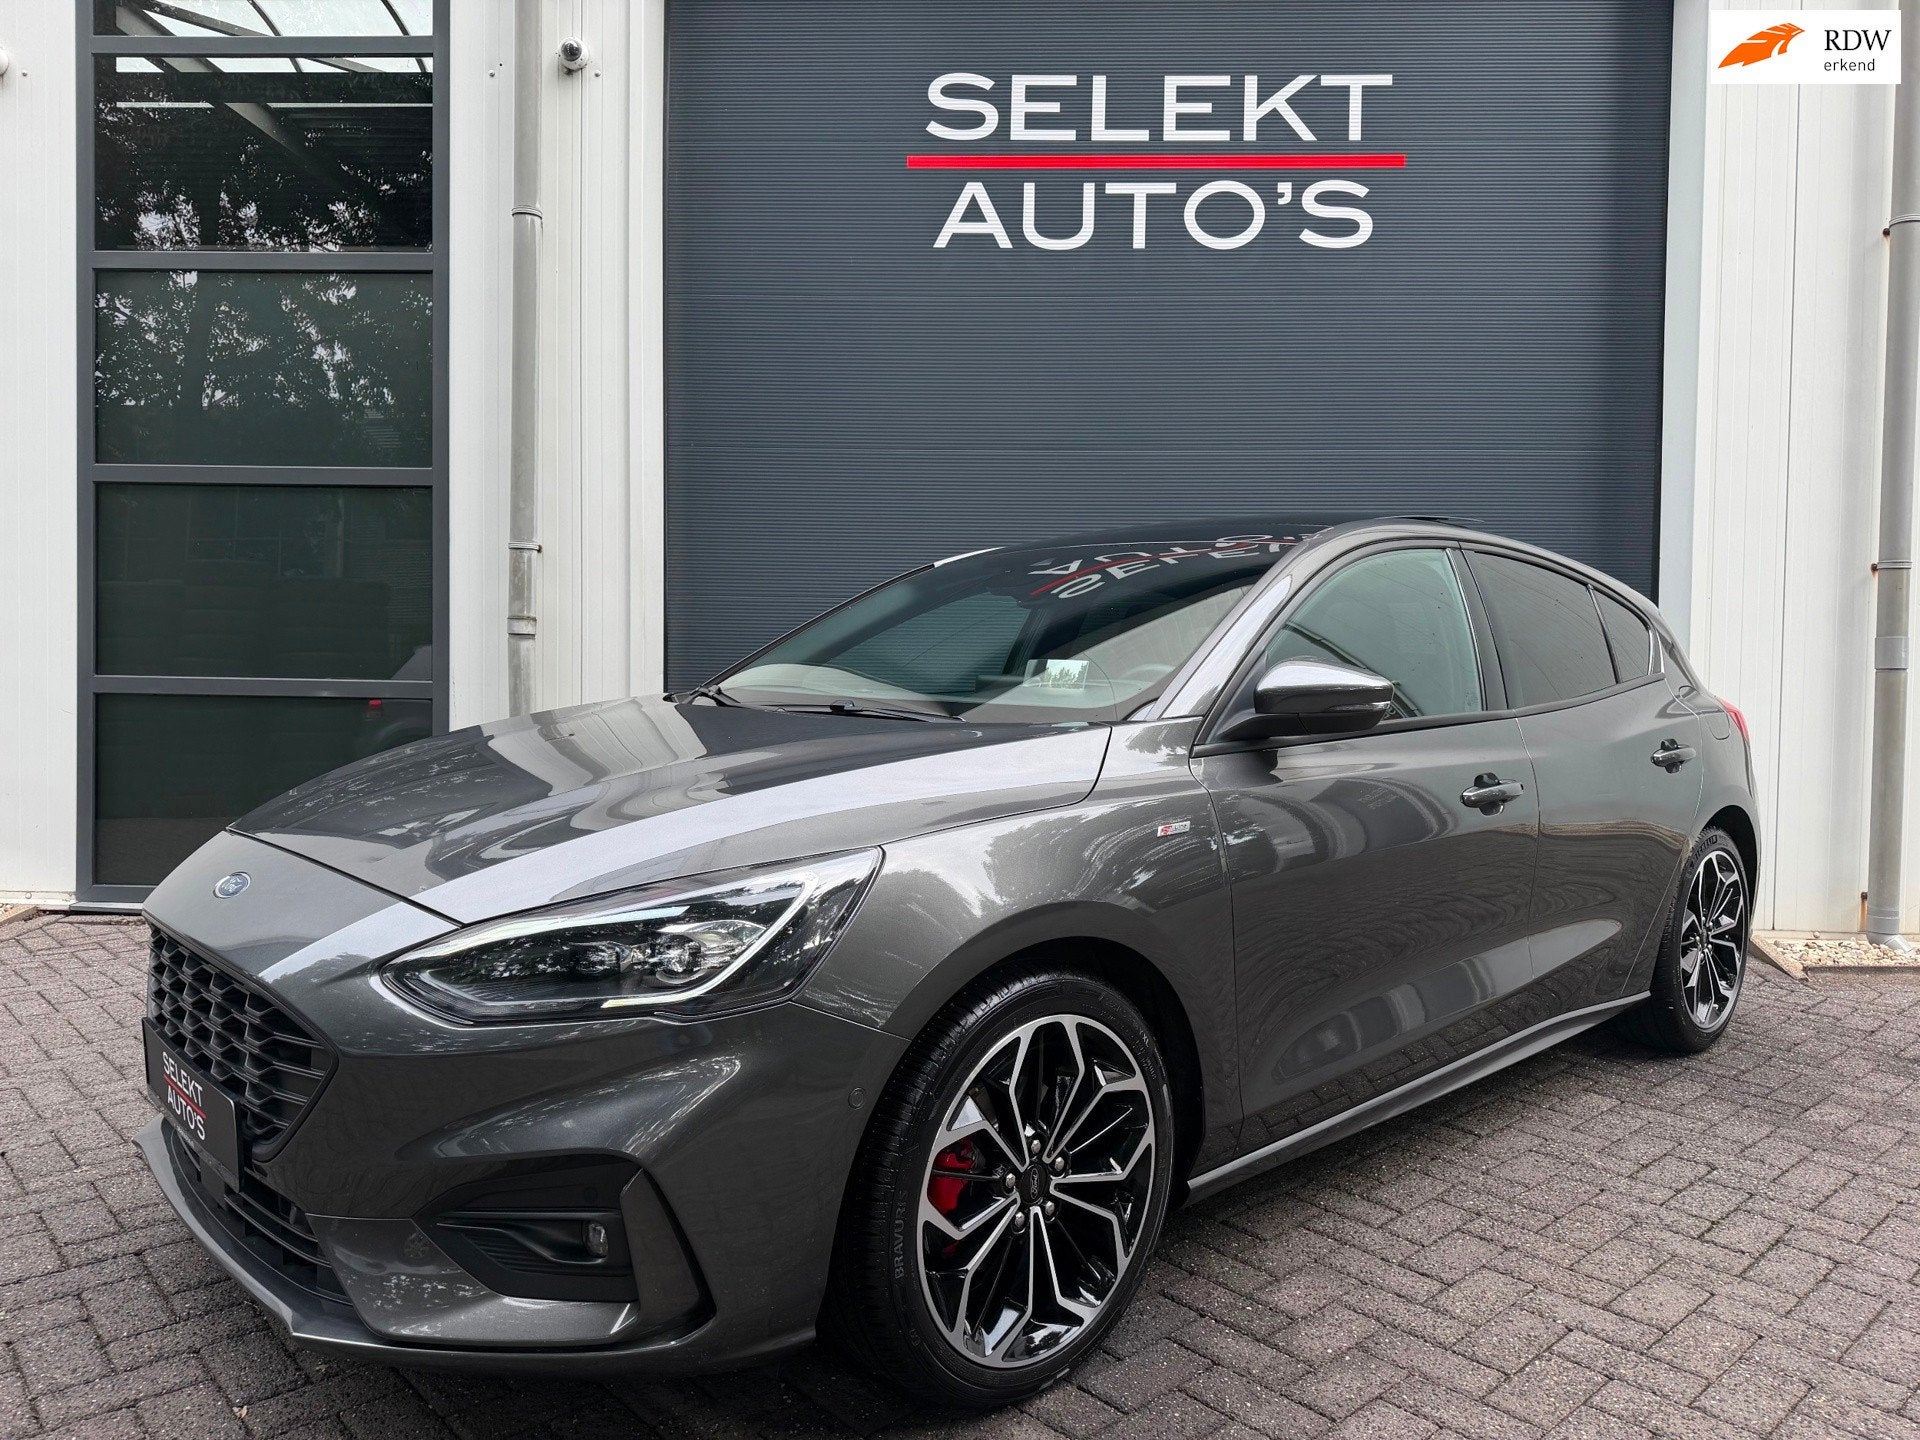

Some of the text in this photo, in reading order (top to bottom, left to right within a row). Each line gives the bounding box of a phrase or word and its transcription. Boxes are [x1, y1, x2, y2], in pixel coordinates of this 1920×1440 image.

[925, 72, 1393, 141] SELEKT
[933, 180, 1373, 250] AUTO'S
[162, 1051, 204, 1107] SELEKT
[167, 1085, 206, 1141] AUTO'S
